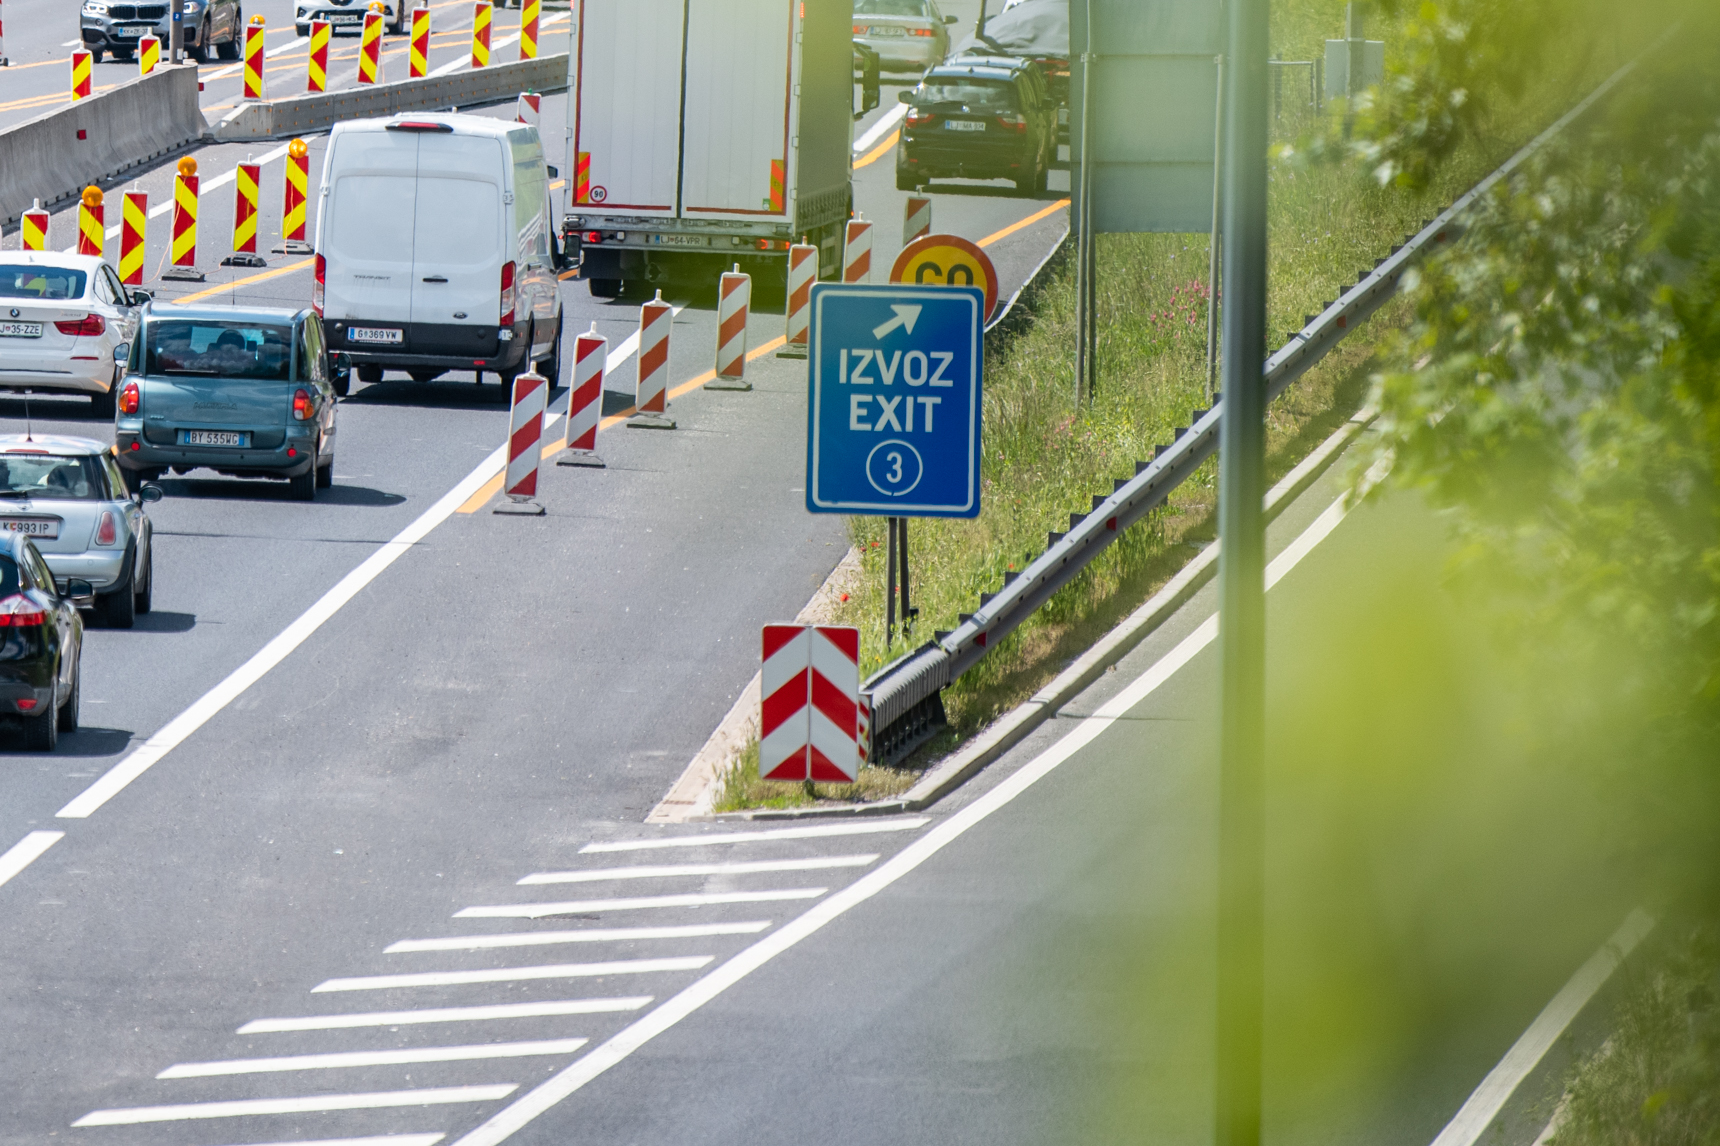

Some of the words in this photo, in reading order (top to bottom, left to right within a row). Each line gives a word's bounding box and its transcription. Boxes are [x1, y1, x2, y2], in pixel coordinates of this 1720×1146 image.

[594, 190, 604, 198] 90
[661, 235, 670, 243] LJ
[11, 325, 40, 334] 35-ZZE
[357, 329, 363, 338] G
[368, 330, 384, 339] 369
[839, 348, 953, 387] IZVOZ
[849, 394, 942, 433] EXIT
[191, 432, 202, 443] BY
[886, 452, 903, 483] 3
[16, 523, 37, 533] 993
